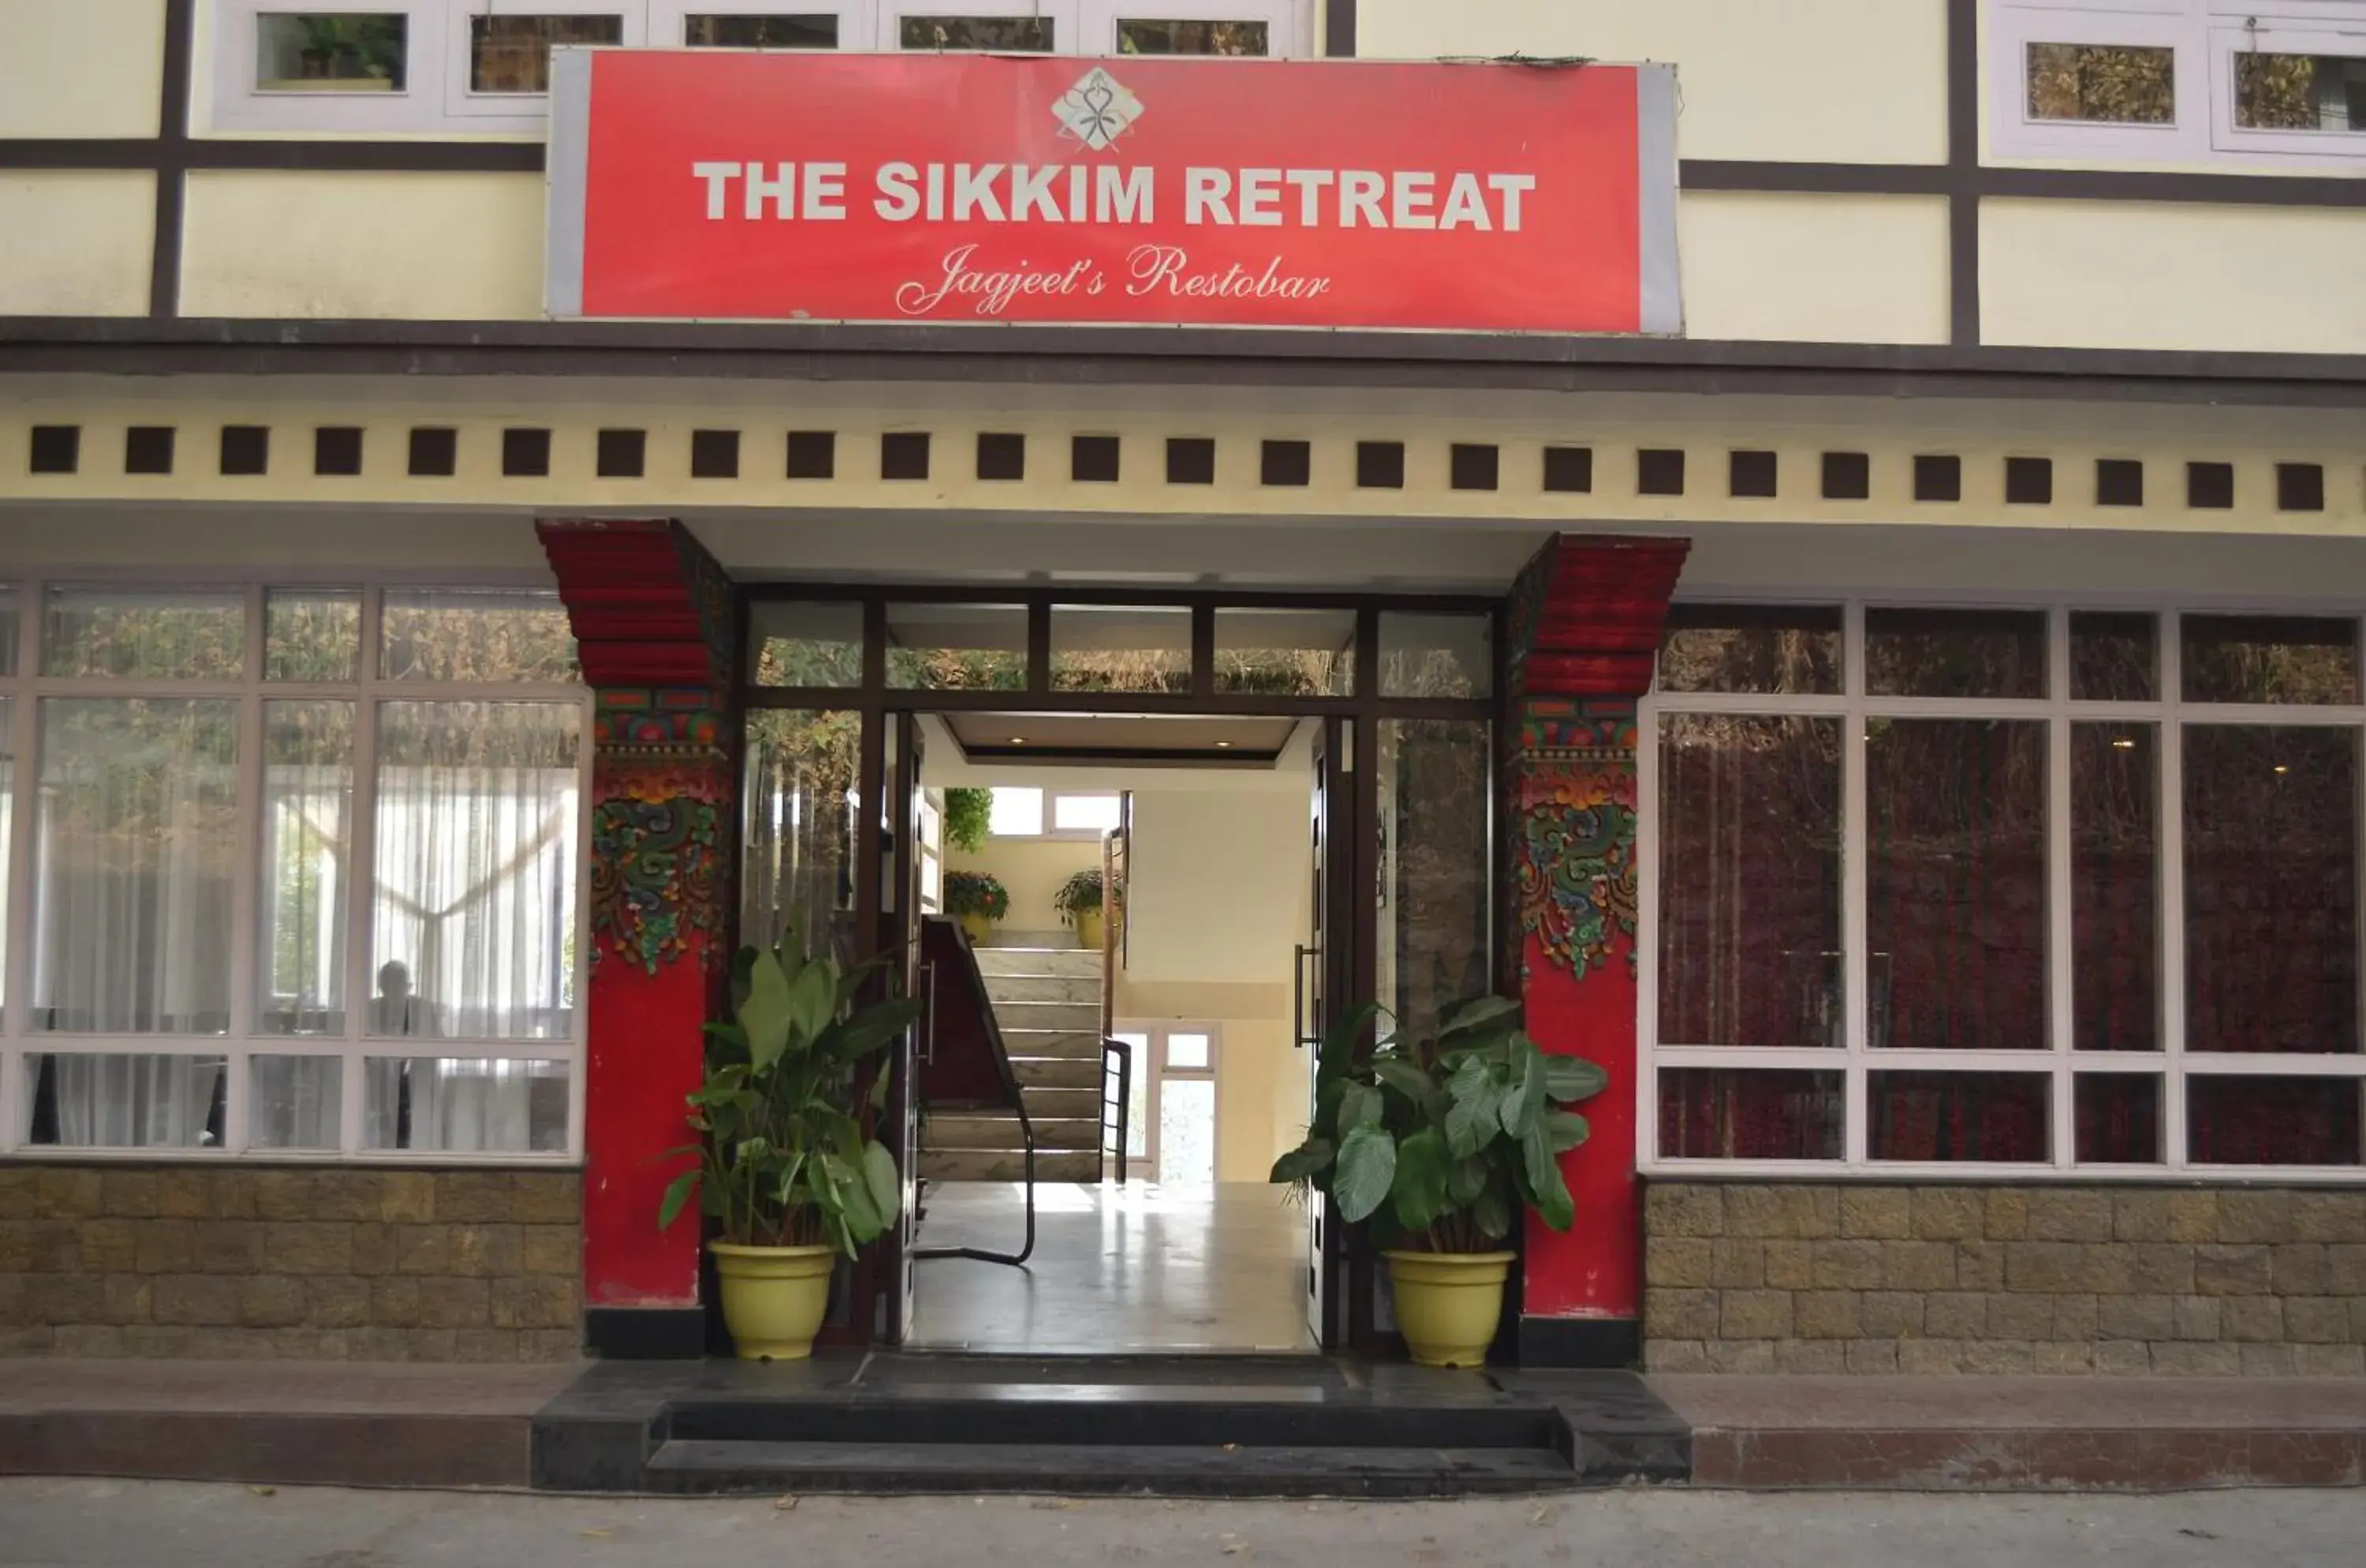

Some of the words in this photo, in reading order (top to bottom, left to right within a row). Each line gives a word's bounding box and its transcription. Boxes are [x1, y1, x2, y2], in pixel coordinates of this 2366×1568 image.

[692, 160, 848, 221] THE
[873, 160, 1156, 224] SIKKIM
[1185, 166, 1537, 233] RETREAT
[895, 244, 1106, 317] Jagjeet's
[1125, 244, 1332, 301] Restobar
